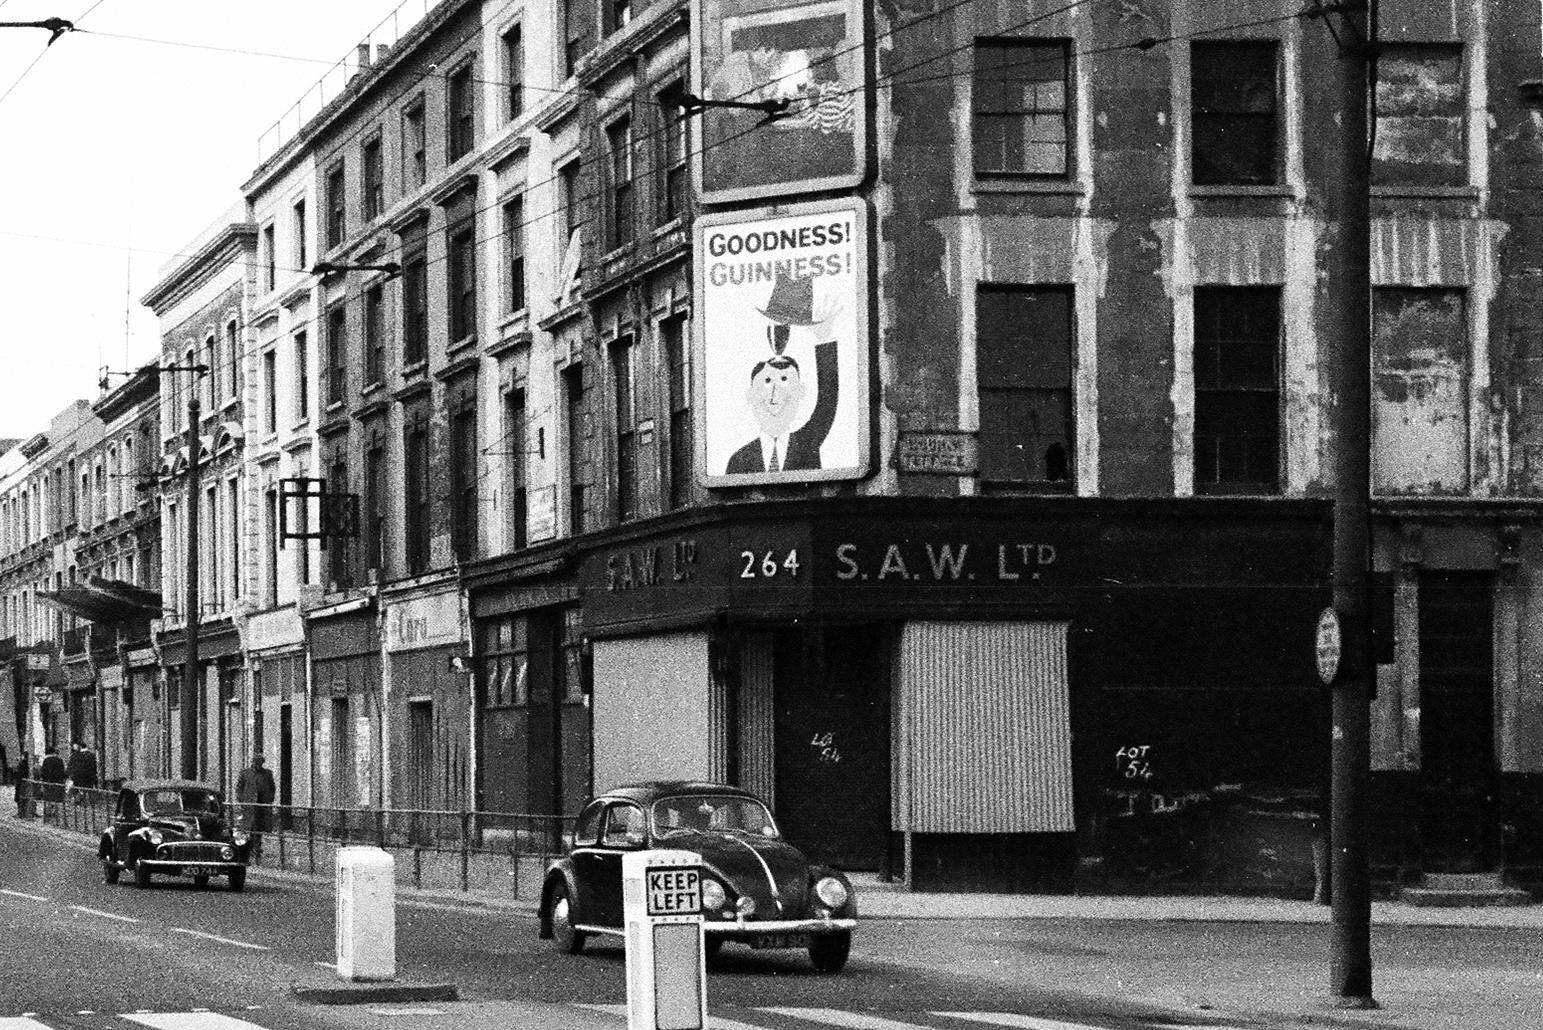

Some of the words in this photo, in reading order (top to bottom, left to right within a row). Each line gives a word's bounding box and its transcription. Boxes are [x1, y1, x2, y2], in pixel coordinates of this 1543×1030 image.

[709, 221, 851, 257] GOODNESS!
[709, 252, 851, 287] GUINNESS!
[740, 549, 800, 579] 264
[836, 543, 976, 580] S.A.W.
[1124, 760, 1153, 779] 54
[650, 873, 698, 892] KEEP
[654, 892, 697, 911] LEFT
